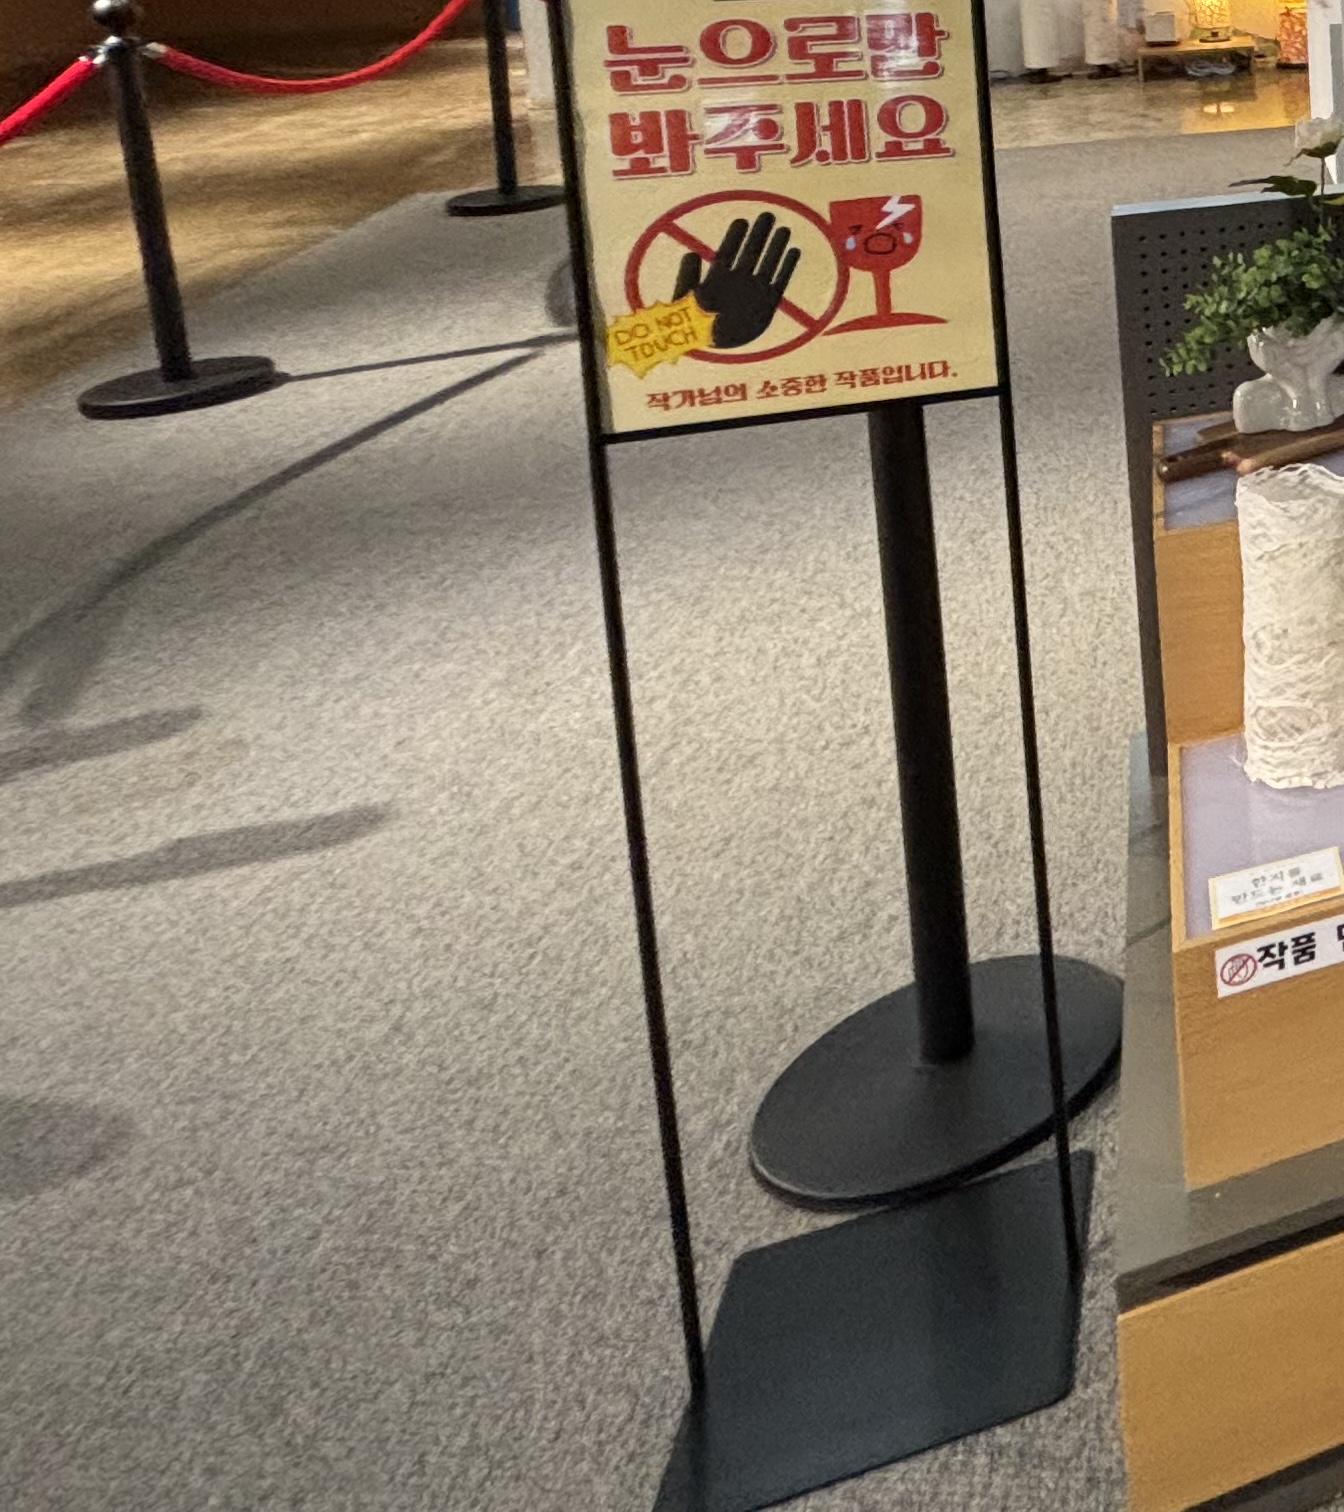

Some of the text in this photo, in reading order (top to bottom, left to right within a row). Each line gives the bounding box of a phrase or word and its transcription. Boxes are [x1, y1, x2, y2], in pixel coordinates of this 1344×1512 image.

[603, 11, 949, 95] 눈으로만
[608, 94, 955, 179] 봐주세요
[615, 307, 692, 345] DO NOT
[624, 327, 698, 362] TOUCH
[646, 359, 960, 413] 작가님의 소중한 작품입니다.
[1256, 932, 1317, 971] 작품
